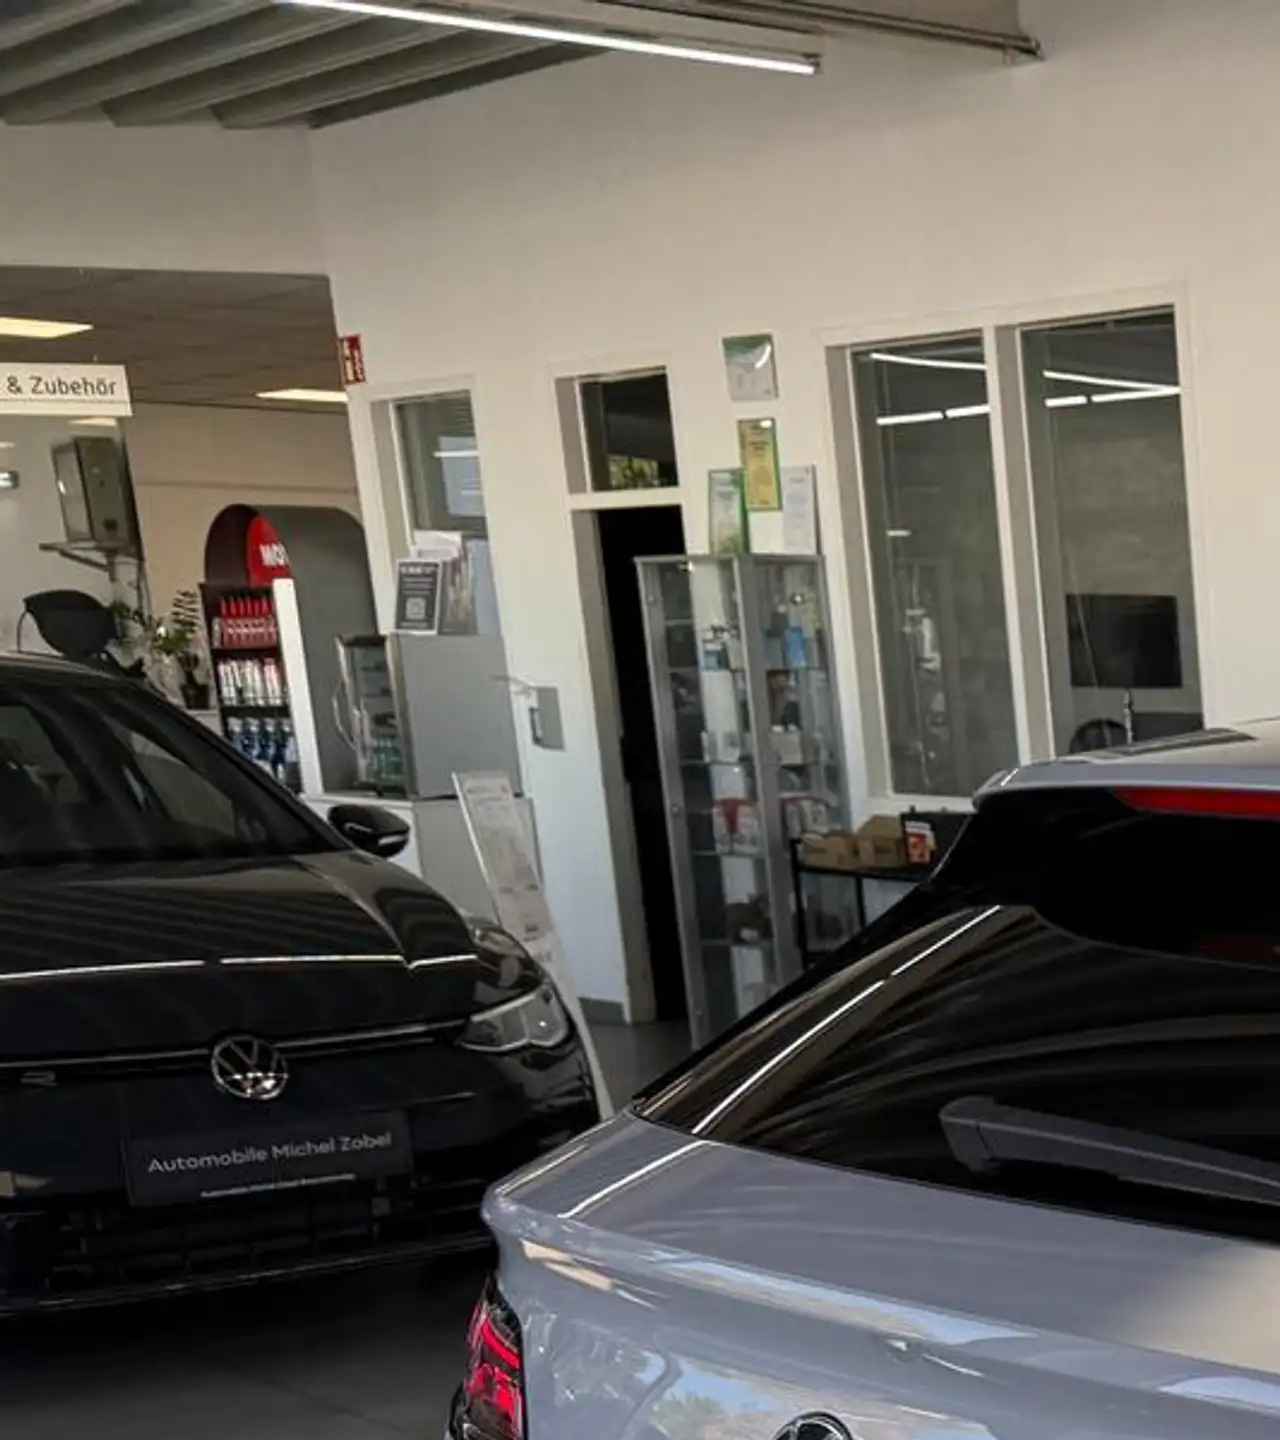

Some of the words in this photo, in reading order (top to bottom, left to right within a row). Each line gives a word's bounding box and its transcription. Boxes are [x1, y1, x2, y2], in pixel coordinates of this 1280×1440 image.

[7, 375, 22, 396] &
[29, 375, 117, 397] Zubehör
[148, 1144, 267, 1174] Automobile
[270, 1137, 336, 1160] Michel
[340, 1131, 392, 1152] Zobel
